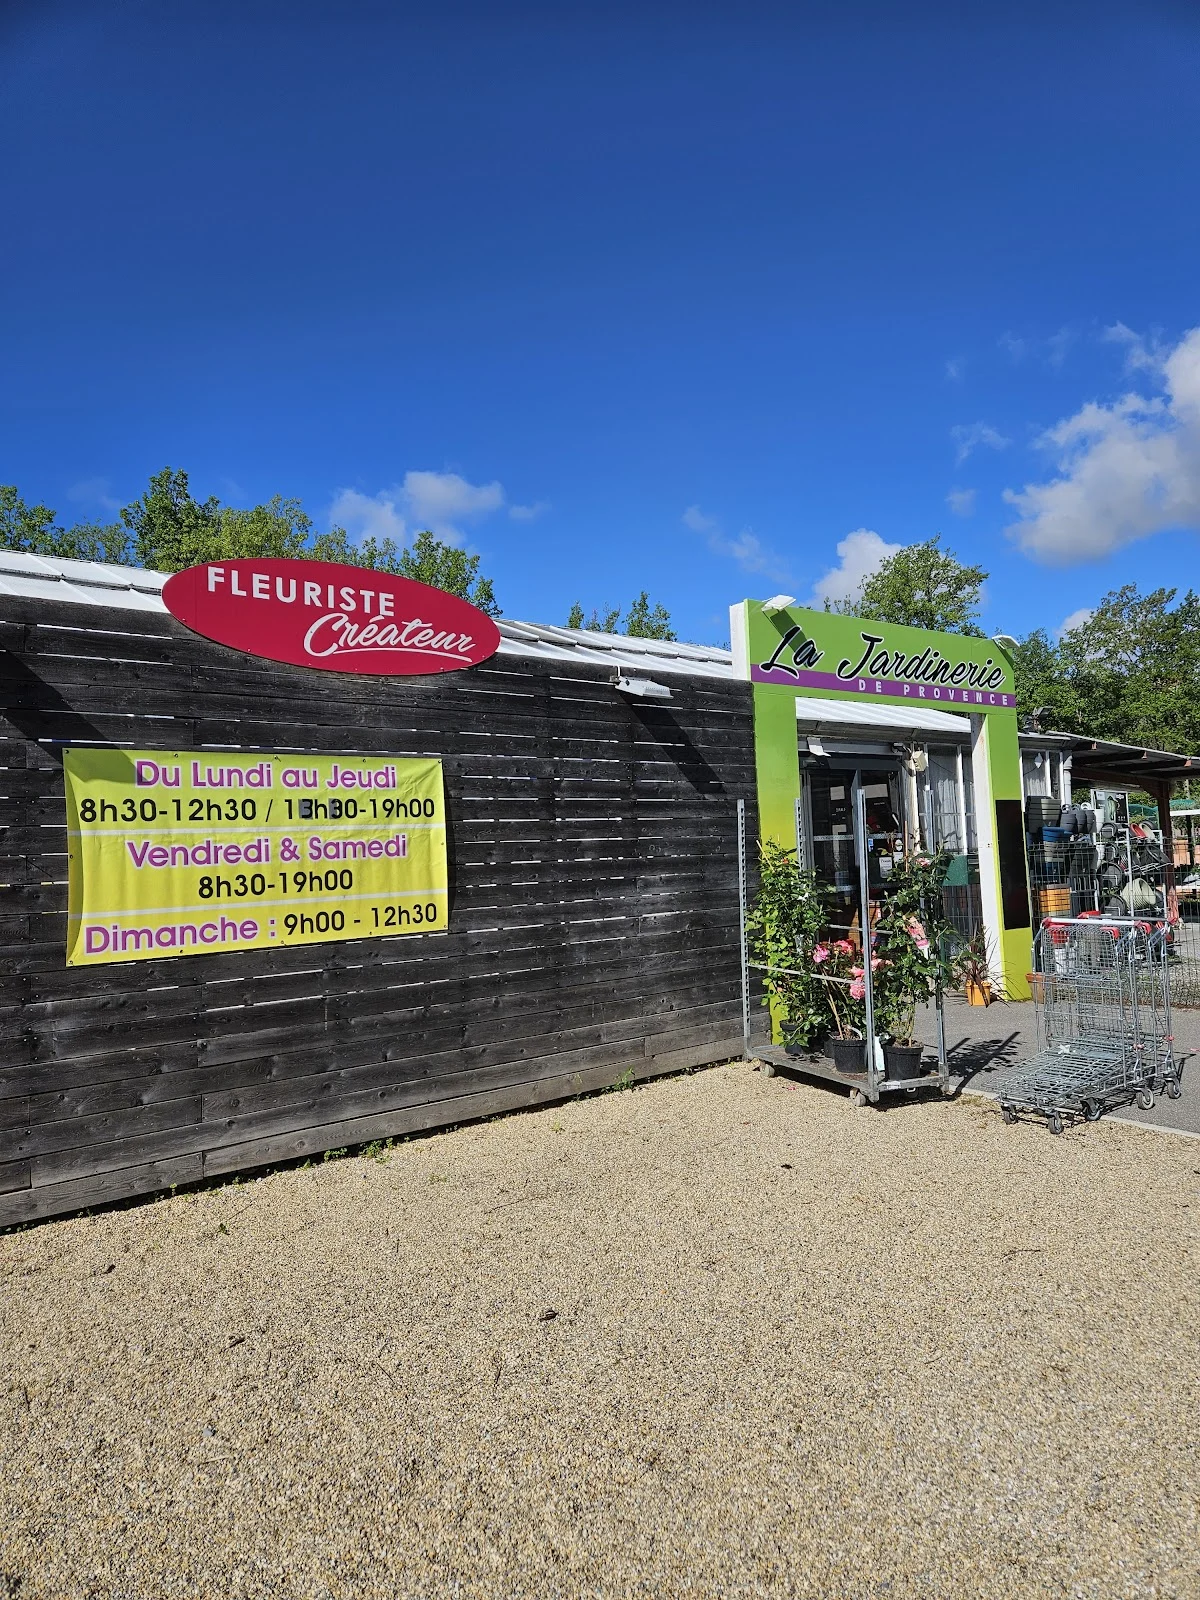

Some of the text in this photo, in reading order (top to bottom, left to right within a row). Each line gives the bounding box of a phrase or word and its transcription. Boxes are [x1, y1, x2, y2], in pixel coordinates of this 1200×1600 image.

[208, 566, 395, 617] FLEURISTE
[304, 612, 476, 658] Créateur
[759, 625, 1006, 690] La Jardinerie
[859, 680, 1008, 705] DE PROVENCE
[136, 761, 396, 789] Du Lundi au Jeudi
[79, 798, 257, 823] 8h30-12h30
[127, 835, 406, 867] Vendredi & Samedi
[198, 869, 353, 899] 8h30-19h00
[85, 916, 258, 954] Dimanche
[283, 909, 346, 936] 9h00
[371, 902, 438, 928] 12h30
